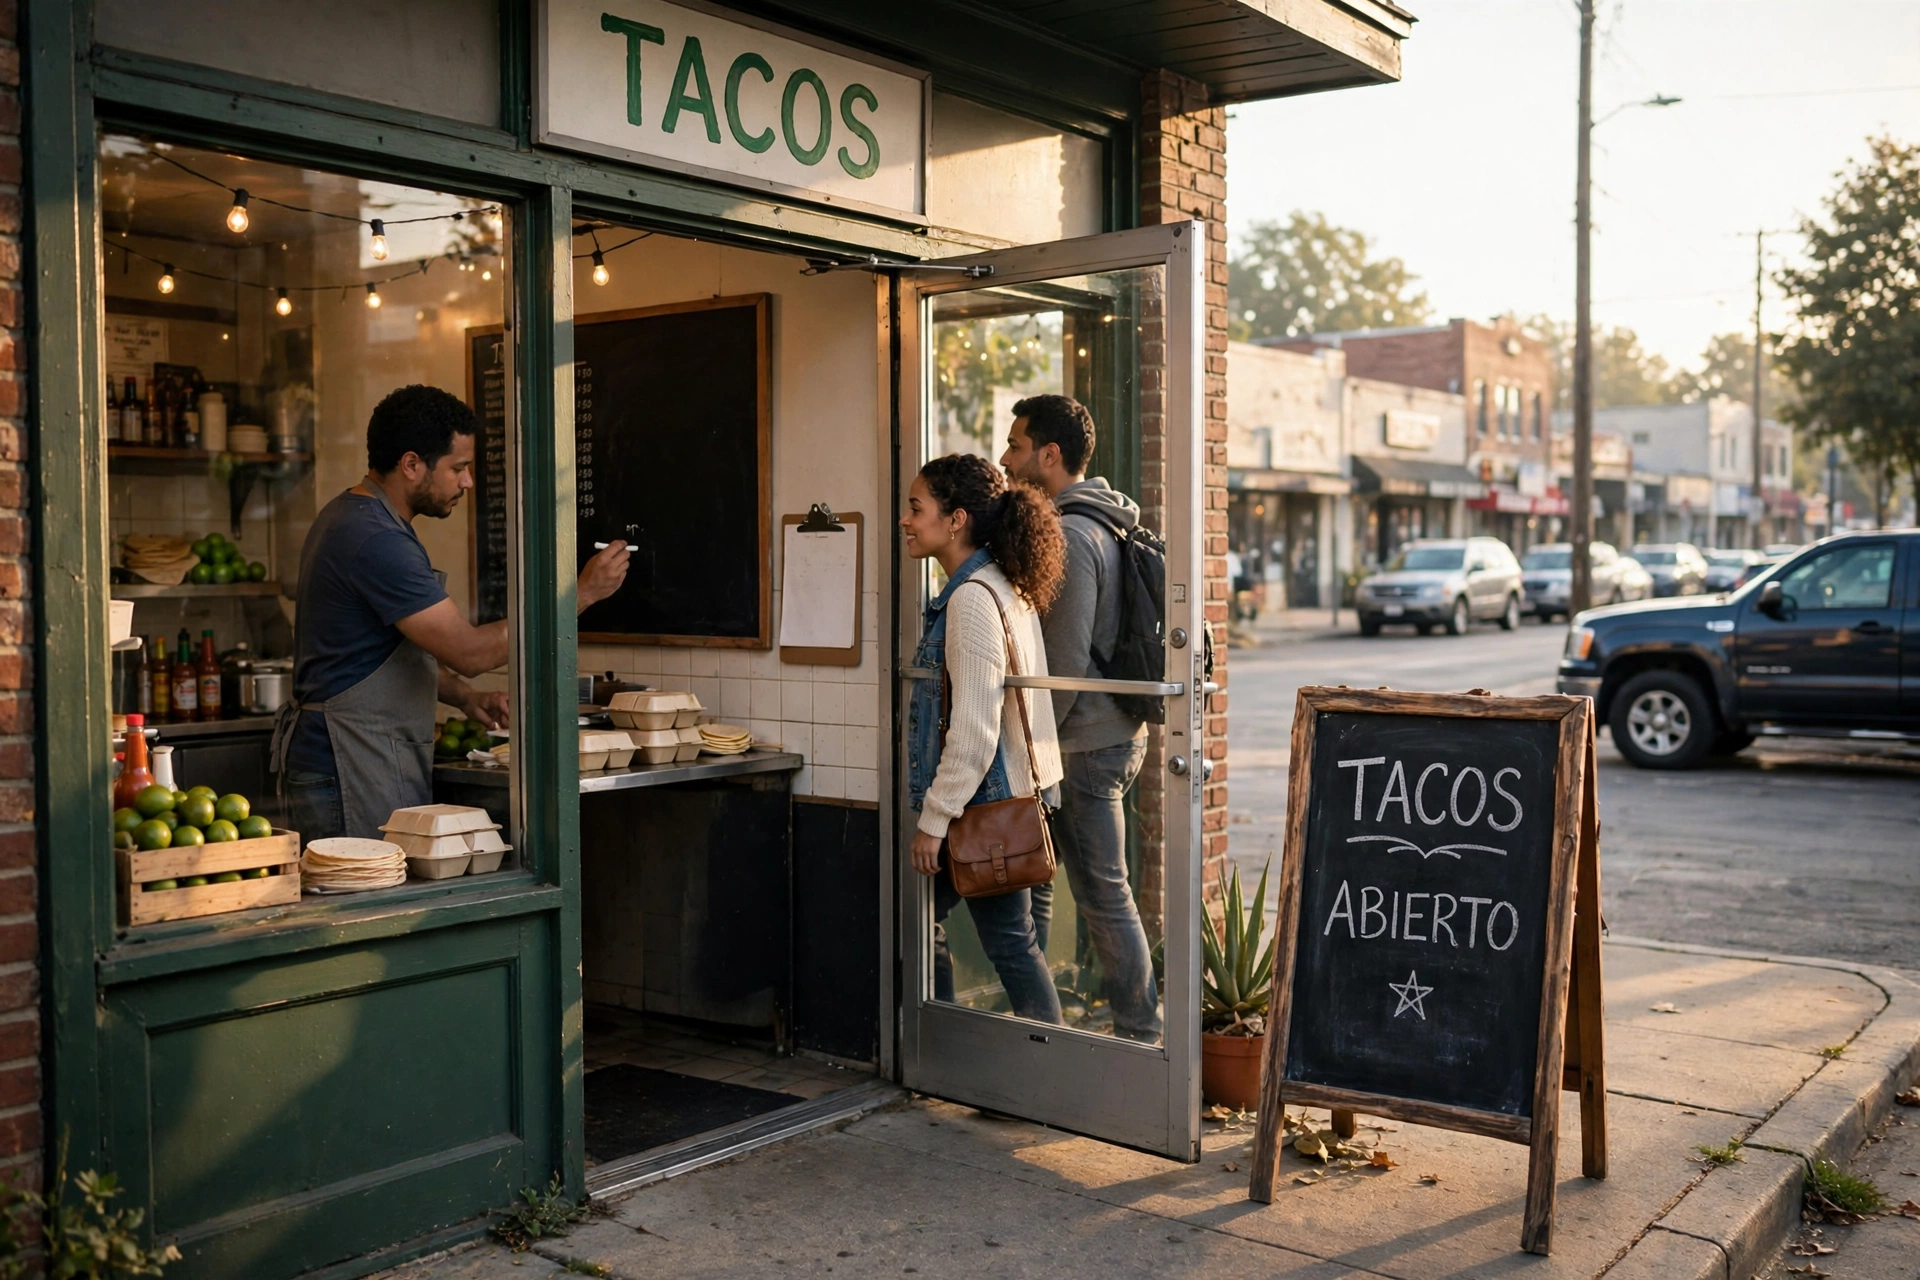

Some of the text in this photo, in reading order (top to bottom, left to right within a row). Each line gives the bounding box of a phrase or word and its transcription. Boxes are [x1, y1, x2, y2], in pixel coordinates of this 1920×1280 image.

[601, 12, 880, 179] TACOS
[1338, 756, 1523, 832] TACOS
[1324, 880, 1519, 950] ABIERTO
